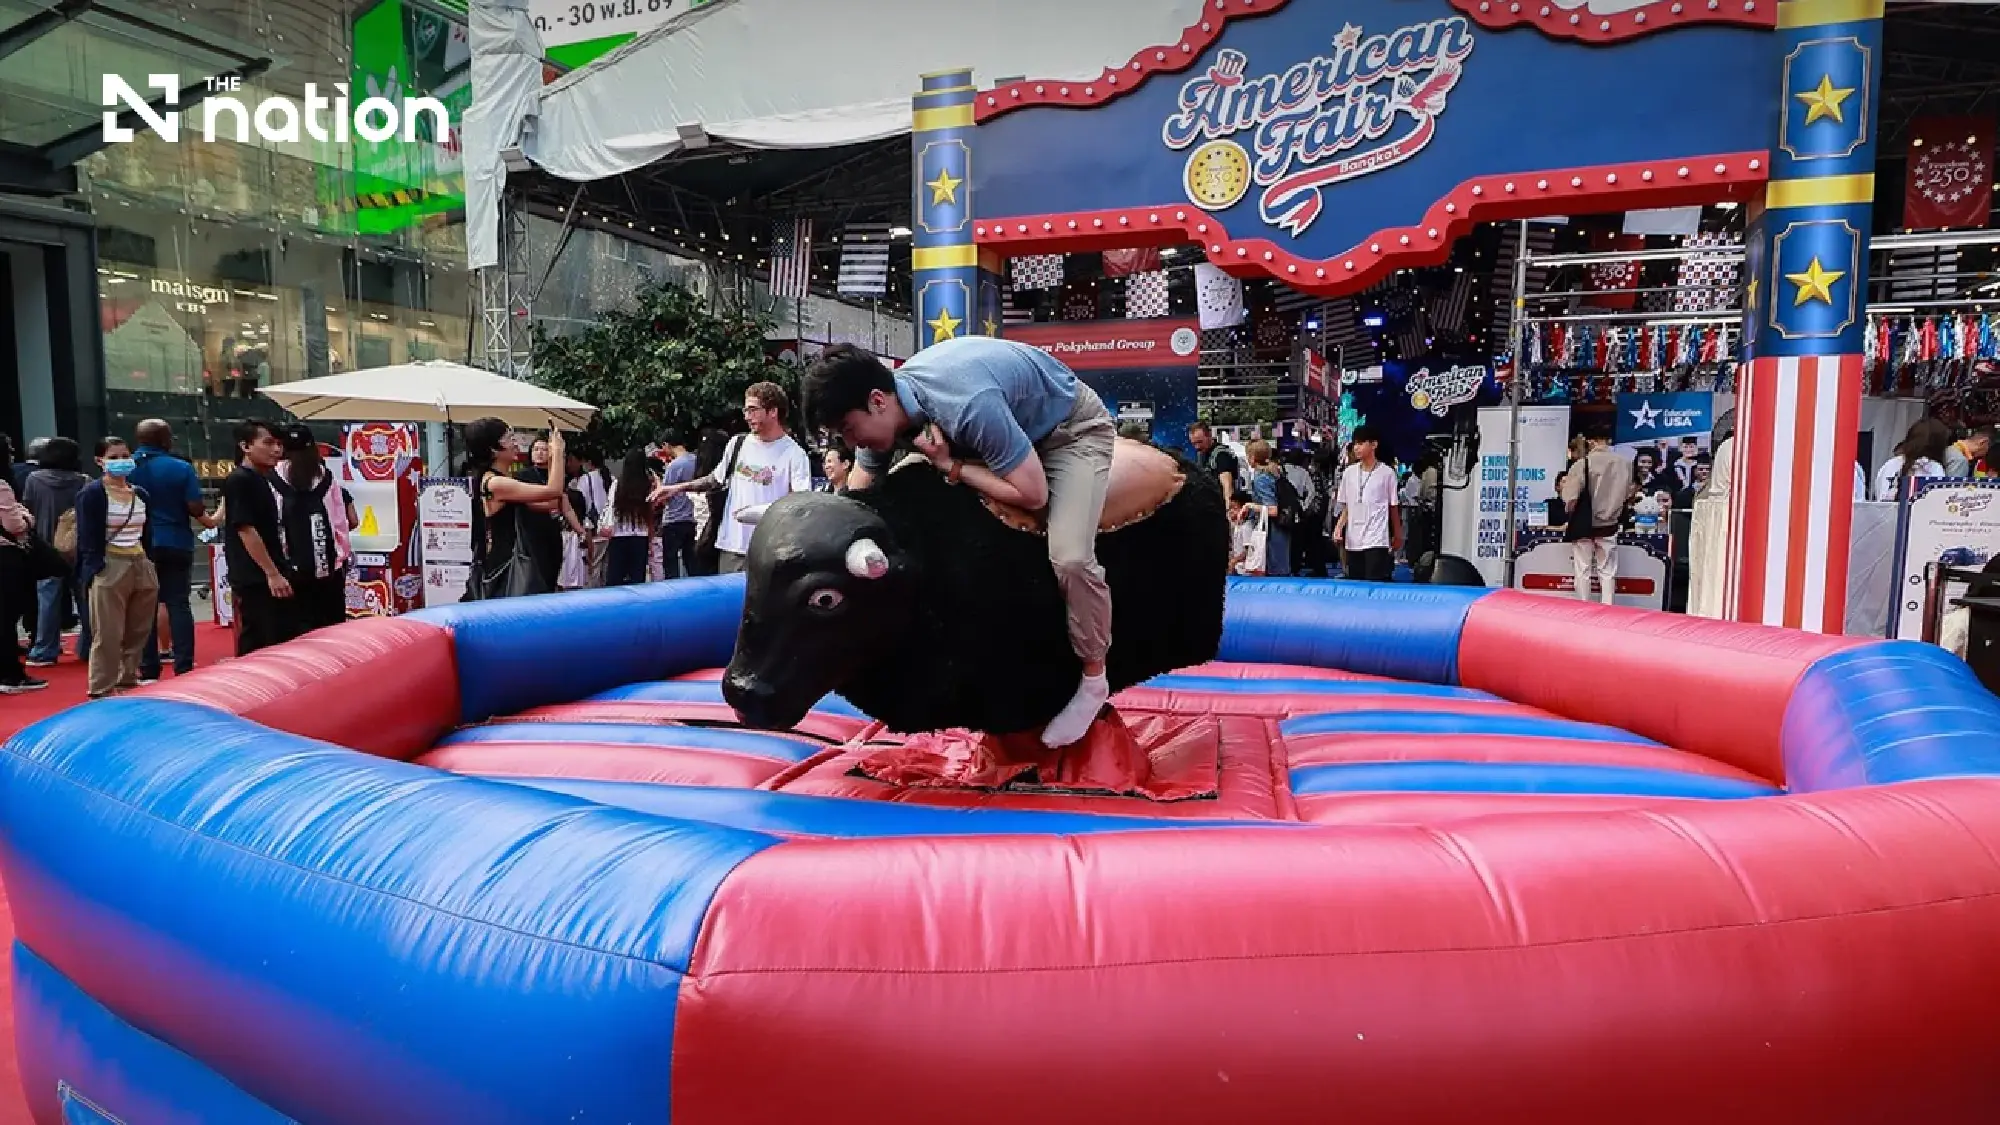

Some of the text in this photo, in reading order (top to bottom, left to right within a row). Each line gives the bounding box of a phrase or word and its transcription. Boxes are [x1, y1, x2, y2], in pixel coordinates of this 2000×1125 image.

[568, 2, 595, 26] 30
[1163, 17, 1474, 149] American
[1254, 85, 1395, 186] Fair
[1339, 145, 1402, 174] Bangkok
[1929, 167, 1970, 187] 250
[151, 276, 229, 304] maison
[1055, 339, 1115, 354] Pokphand
[1116, 338, 1156, 351] Group
[1405, 365, 1486, 393] American
[1664, 409, 1703, 417] Education
[1664, 416, 1692, 427] USA
[1481, 468, 1546, 481] EDUCTIONS
[1480, 486, 1529, 500] ADVACE
[1479, 501, 1528, 512] CARERS
